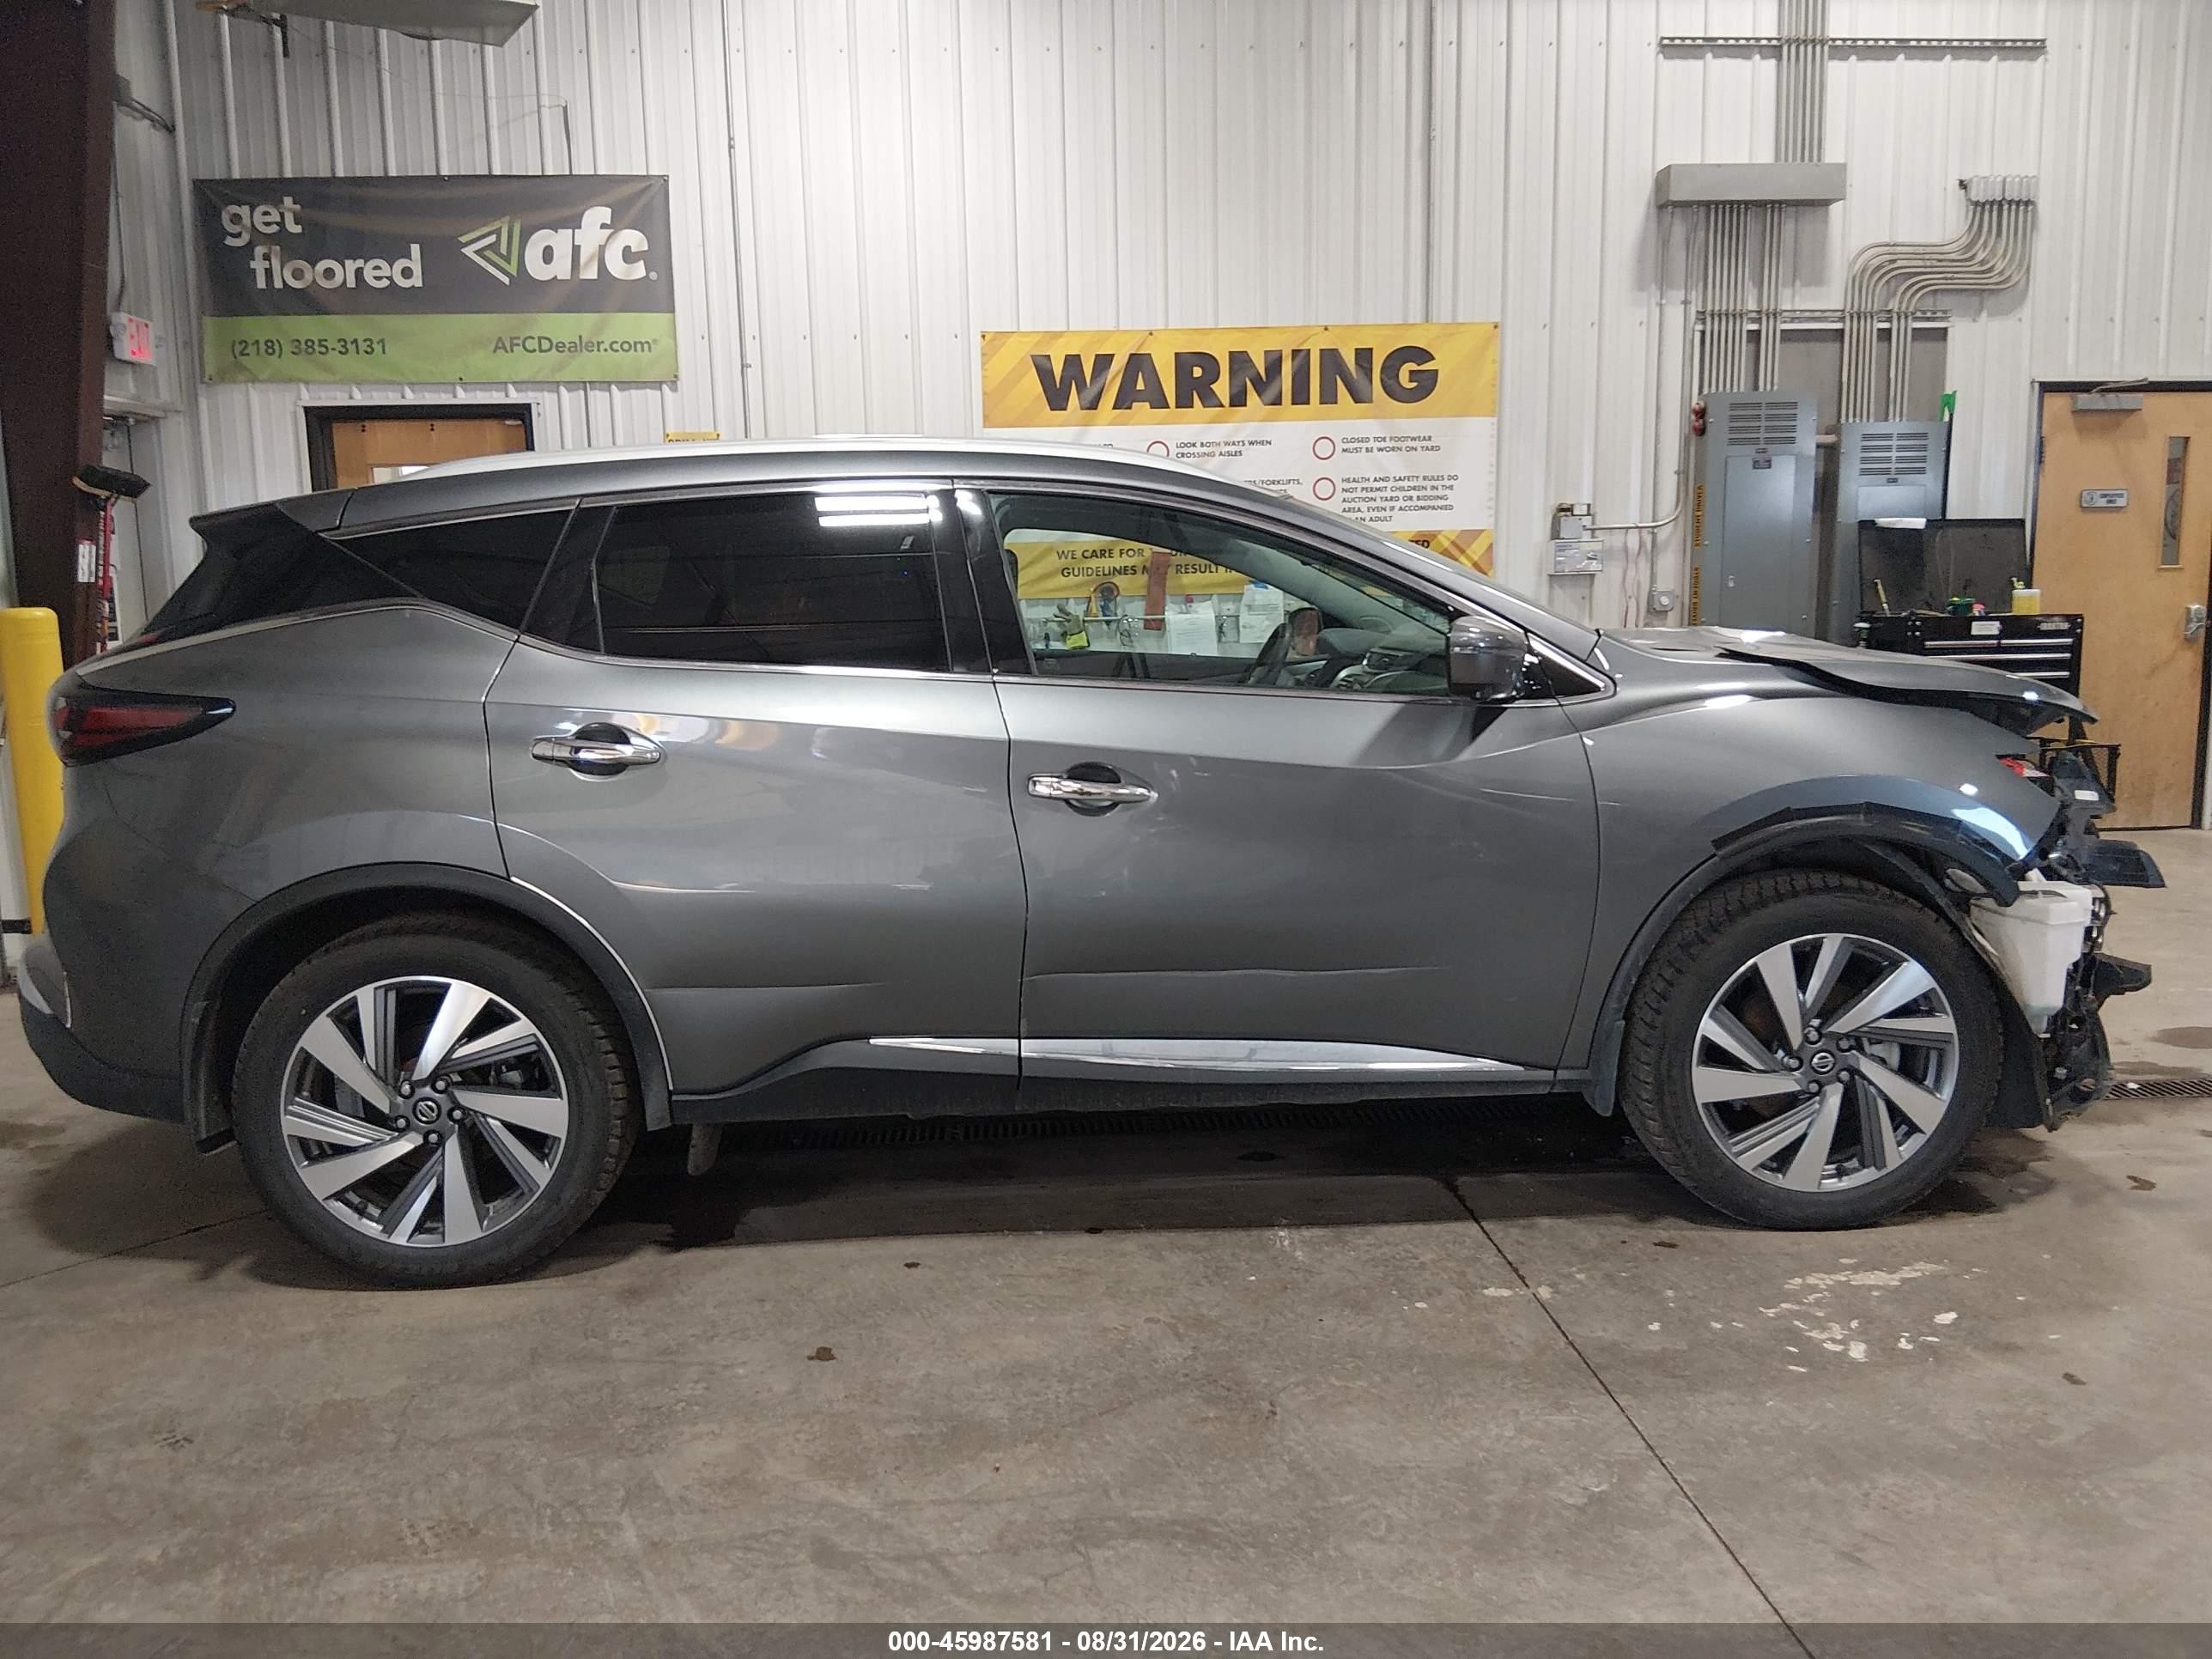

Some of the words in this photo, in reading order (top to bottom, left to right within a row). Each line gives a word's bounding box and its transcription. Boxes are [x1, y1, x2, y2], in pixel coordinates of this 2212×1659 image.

[221, 196, 302, 247] get
[525, 206, 649, 281] afc
[250, 243, 423, 289] floored
[232, 338, 283, 359] (218)
[290, 337, 386, 356] 385-3131
[493, 335, 652, 354] AFCDealer.com
[1031, 345, 1440, 411] WARNING
[1218, 449, 1243, 458] AISLES
[1056, 550, 1077, 560] WE
[1081, 549, 1115, 559] CARE
[1119, 548, 1145, 558] FOR
[1061, 565, 1137, 578] GUIDELINES
